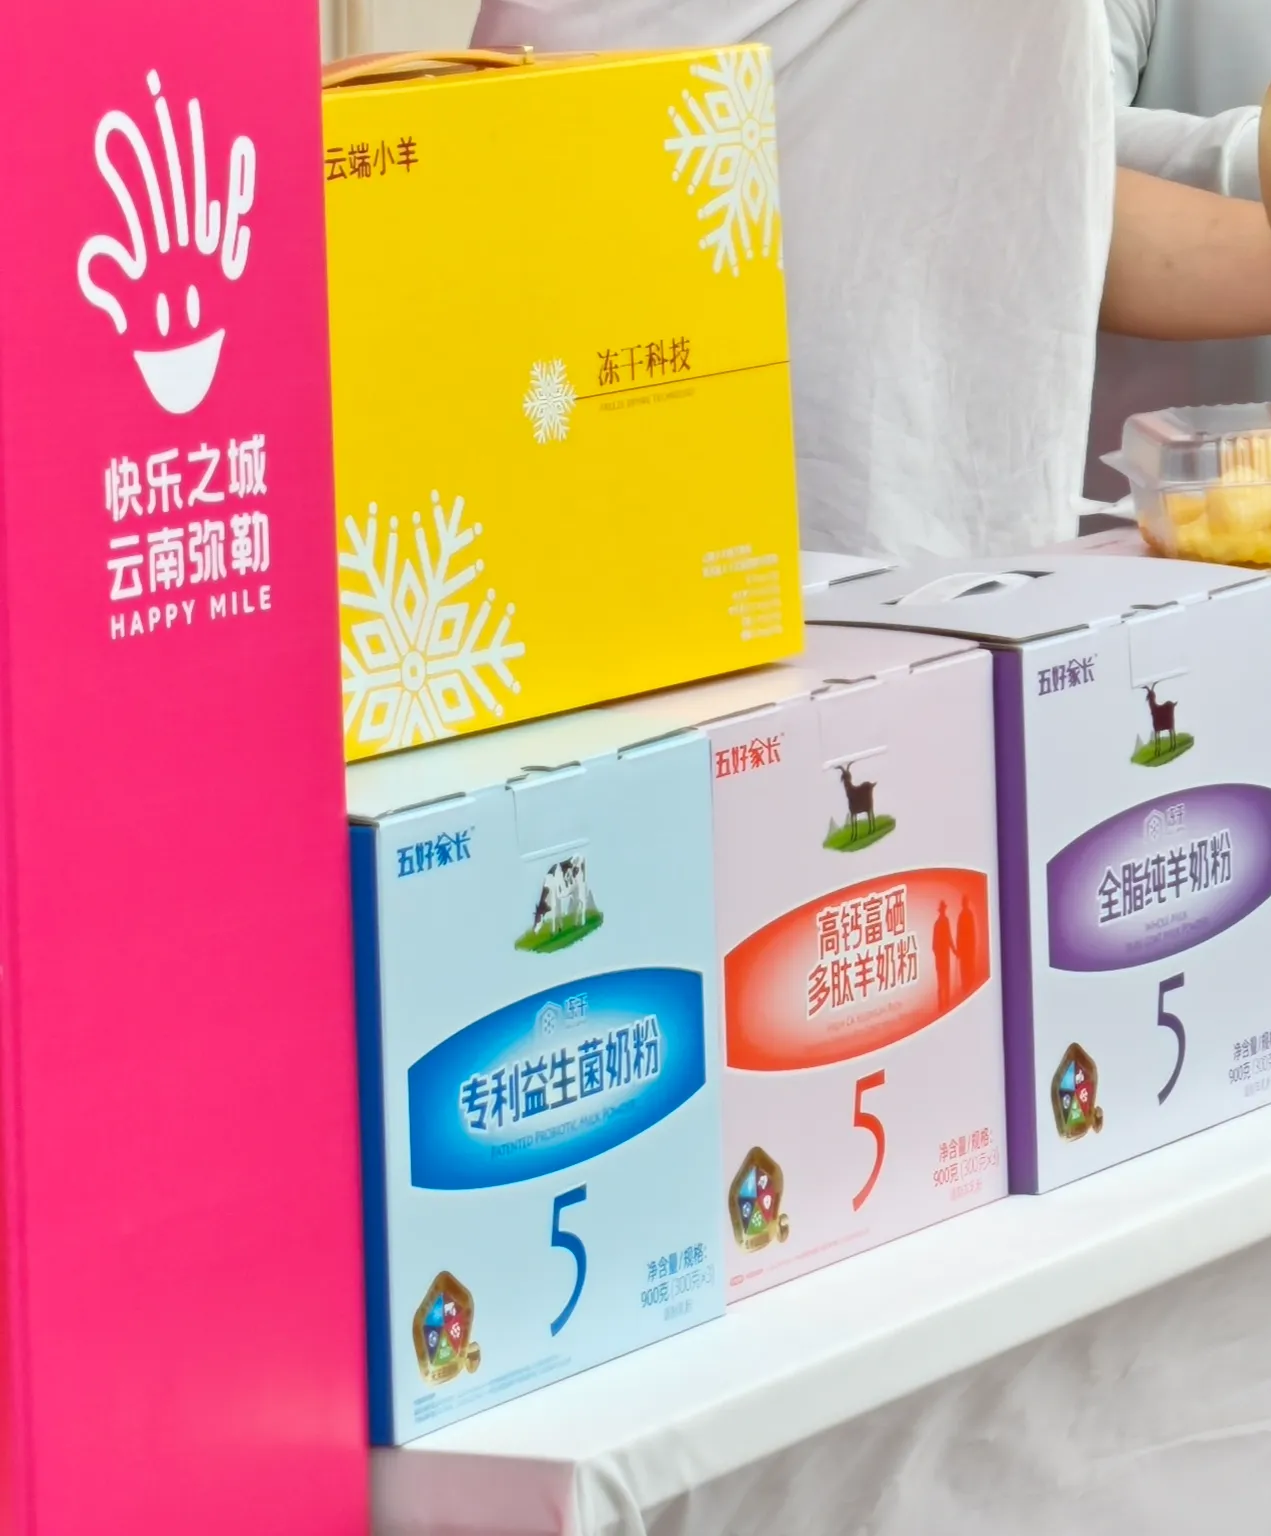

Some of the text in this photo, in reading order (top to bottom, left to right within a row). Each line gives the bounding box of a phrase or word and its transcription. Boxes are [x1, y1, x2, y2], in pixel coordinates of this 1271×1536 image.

[326, 136, 419, 182] 云端小羊
[596, 335, 692, 387] 冻干科技
[104, 433, 268, 521] 快乐之城
[106, 511, 271, 603] 云南弥勒
[109, 584, 272, 641] HAPPY MILE
[1037, 656, 1096, 697] 五好家长
[716, 734, 782, 779] 五好家长
[396, 829, 472, 878] 五好家长
[1099, 830, 1232, 924] 全脂纯羊奶粉
[818, 886, 906, 960] 高钙富硒
[807, 934, 919, 1019] 多肽羊奶粉
[460, 1016, 661, 1132] 专利益生菌奶粉
[1157, 971, 1187, 1107] 5
[852, 1068, 886, 1213] 5
[549, 1183, 588, 1338] 5
